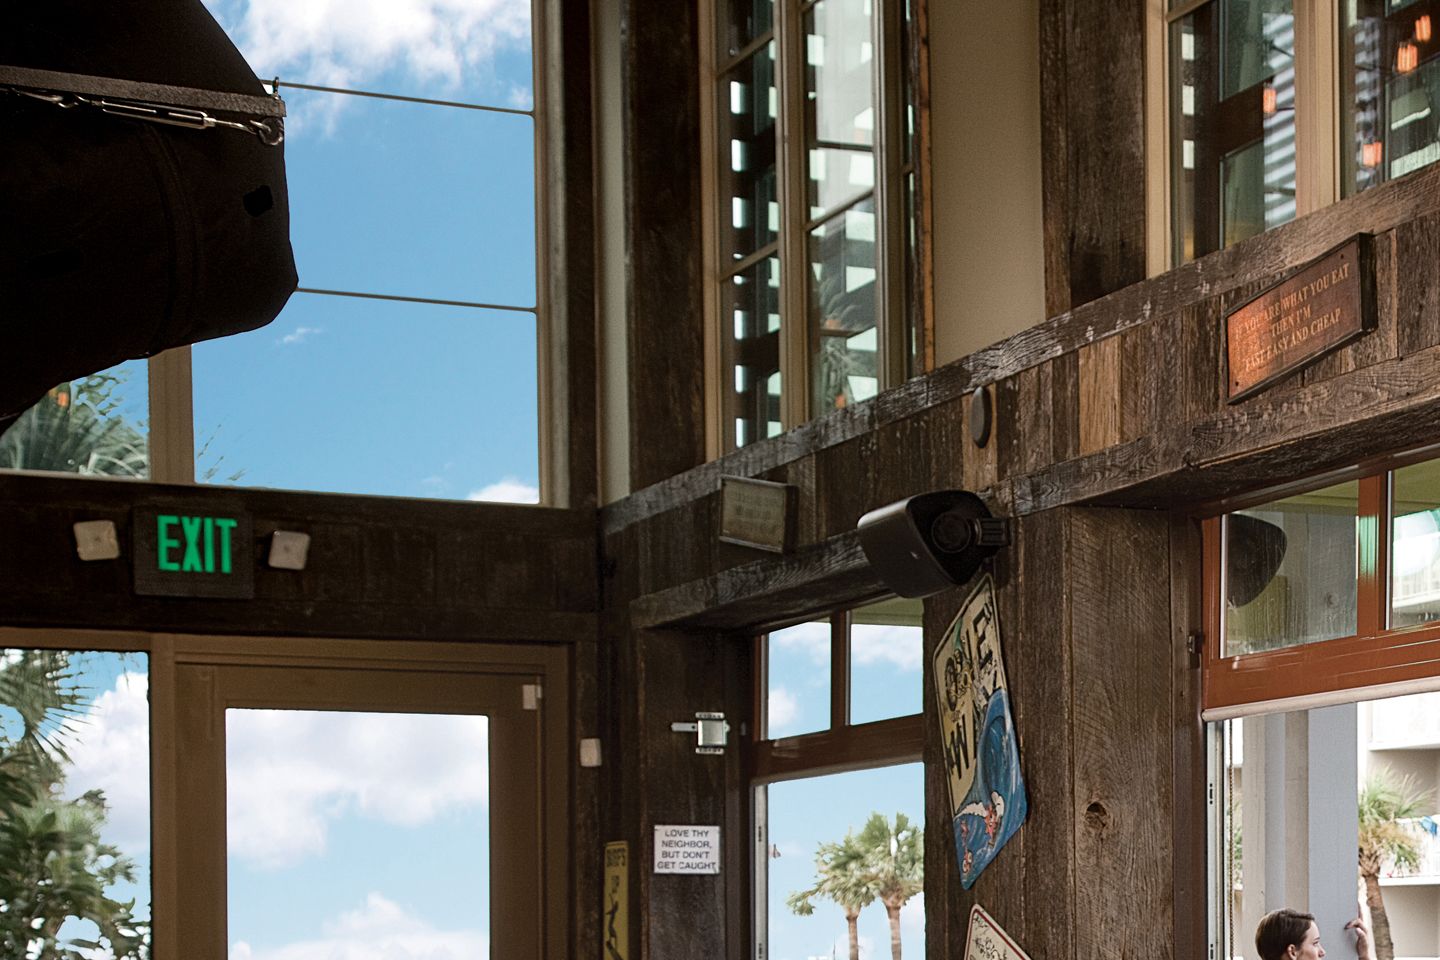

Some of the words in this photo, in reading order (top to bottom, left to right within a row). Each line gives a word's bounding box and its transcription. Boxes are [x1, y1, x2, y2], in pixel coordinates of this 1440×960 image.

[1264, 302, 1281, 322] ARE
[1281, 286, 1309, 311] WHAT
[1310, 277, 1330, 297] YOU
[1331, 262, 1351, 285] EAT
[1271, 312, 1294, 337] THEN
[1295, 304, 1312, 325] I'M
[1290, 325, 1309, 348] AND
[1310, 307, 1342, 336] CHEAP
[157, 514, 238, 574] EXIT
[665, 829, 689, 838] LOVE
[692, 829, 709, 838] THY
[661, 840, 713, 849] NEIGHBOR,
[661, 850, 680, 859] BUT
[683, 850, 710, 859] DON'T
[657, 861, 676, 870] GET
[679, 861, 717, 870] CAUGHT
